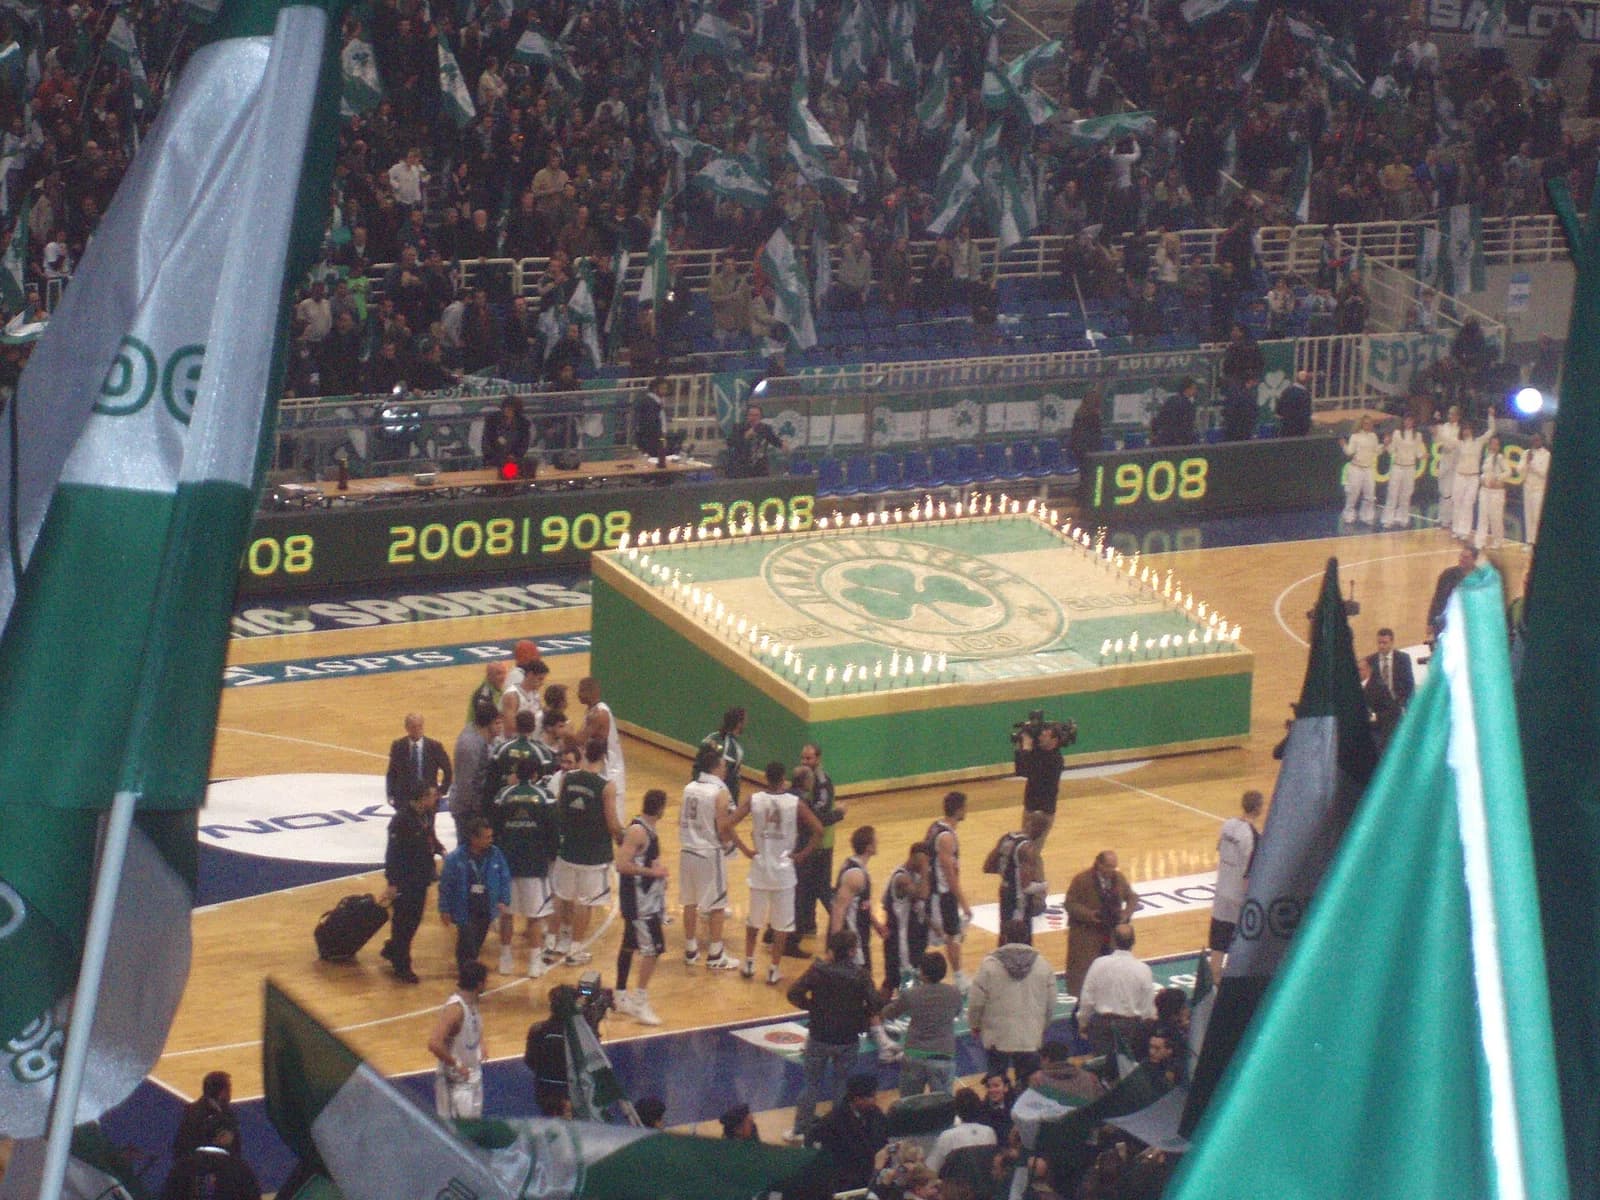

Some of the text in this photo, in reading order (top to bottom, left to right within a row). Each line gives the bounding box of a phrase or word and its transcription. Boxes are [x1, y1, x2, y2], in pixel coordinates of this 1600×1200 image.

[1094, 457, 1209, 507] 1908
[388, 510, 632, 564] 2008 1908
[700, 495, 815, 538] 2008
[240, 534, 314, 576] 08
[231, 583, 592, 639] IC SPORTS
[284, 635, 592, 678] ASPIS BN
[199, 804, 397, 839] NOK
